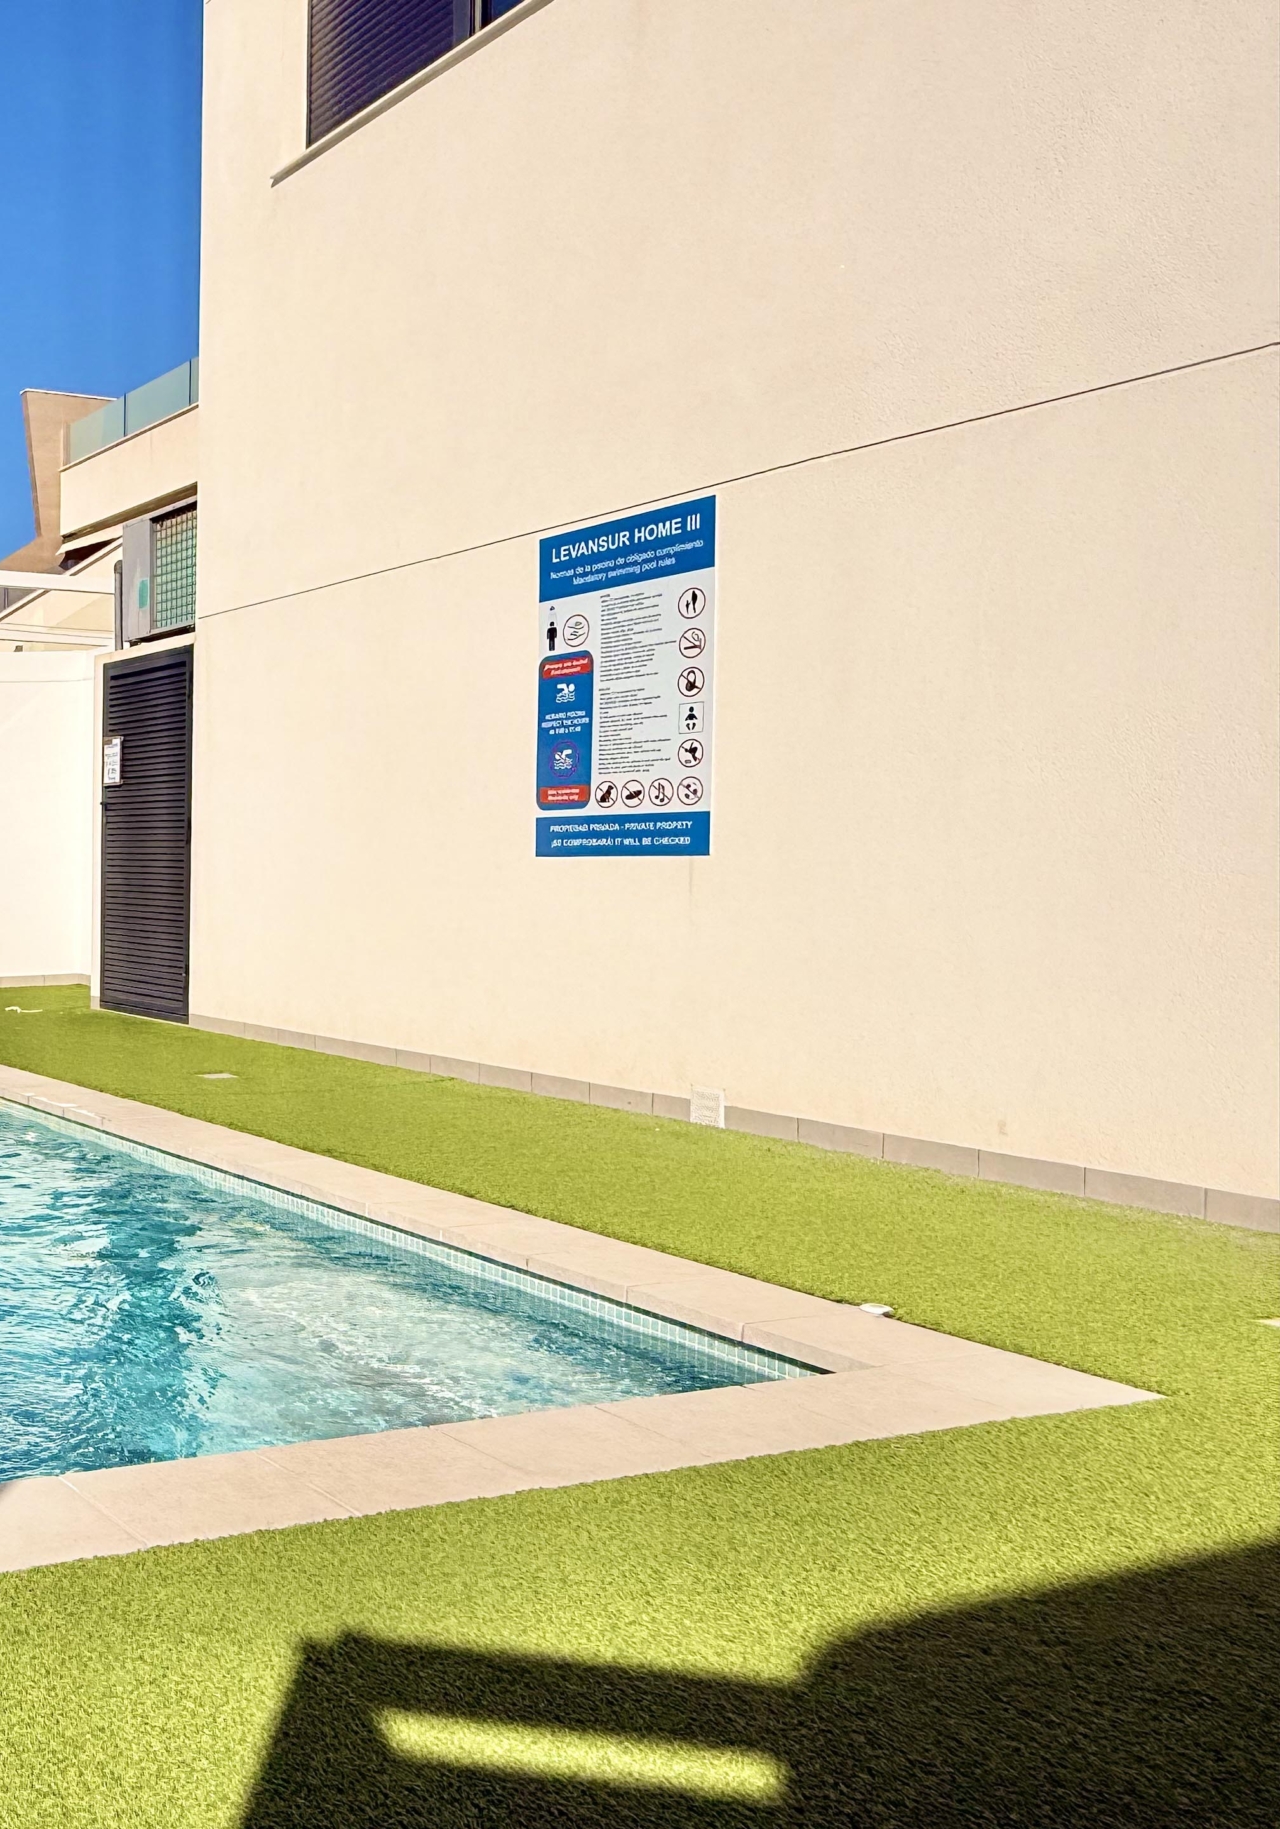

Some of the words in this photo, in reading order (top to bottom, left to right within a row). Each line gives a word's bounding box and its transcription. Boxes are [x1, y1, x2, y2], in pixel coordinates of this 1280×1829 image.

[552, 531, 630, 563] LEVANSUR
[634, 517, 682, 543] HOME
[687, 513, 700, 532] III
